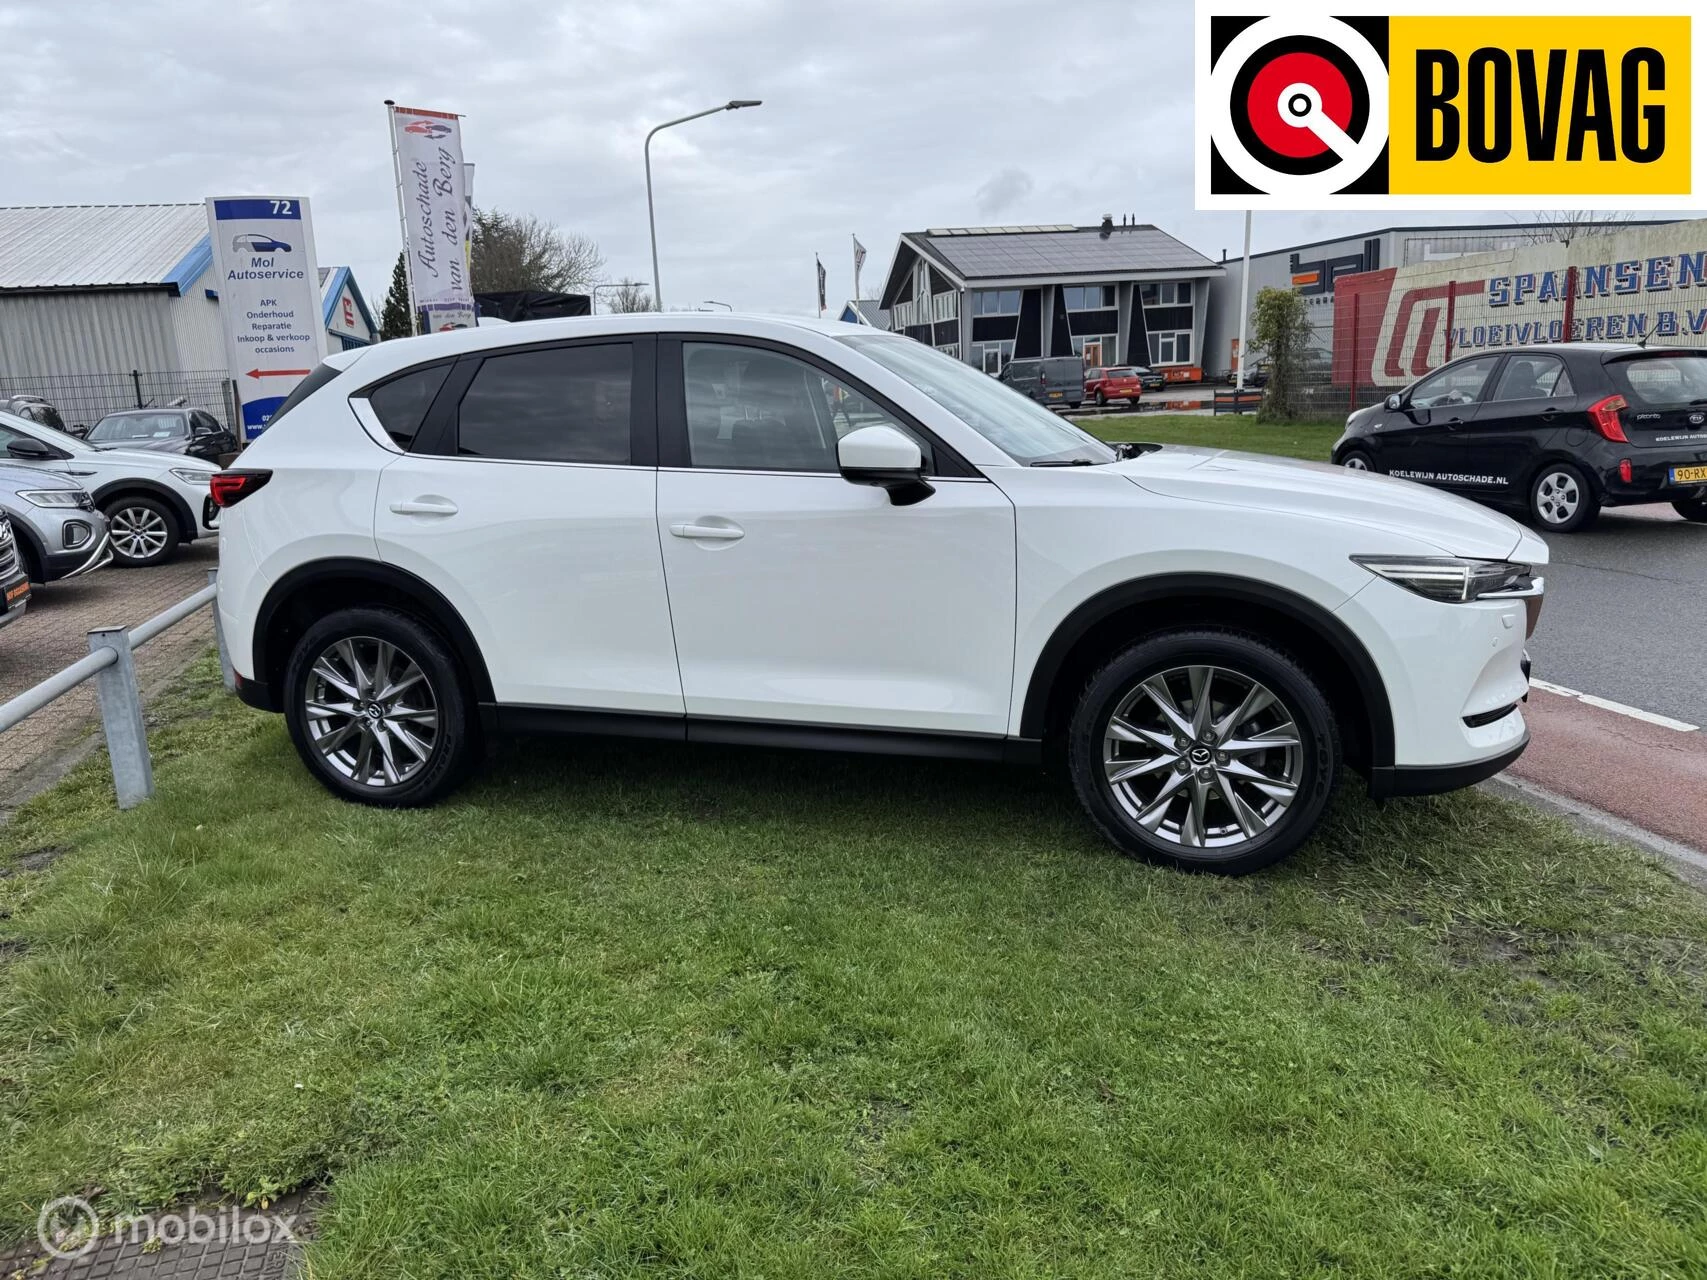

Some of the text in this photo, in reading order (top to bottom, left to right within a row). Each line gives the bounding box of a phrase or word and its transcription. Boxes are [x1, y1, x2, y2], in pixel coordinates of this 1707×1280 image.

[269, 200, 293, 215] 72
[413, 161, 439, 277] Autoschade
[433, 148, 462, 291] van den Berg
[251, 256, 274, 268] Mol
[227, 269, 304, 280] Autoservice
[260, 299, 277, 307] APK
[246, 310, 294, 319] Onderhoud
[251, 322, 292, 331] Reparatie
[237, 335, 265, 343] Inkoop
[276, 333, 310, 342] verkoop
[255, 345, 295, 354] occasions
[1389, 469, 1509, 485] KOELEWIJN AUTOSCHADE.NL
